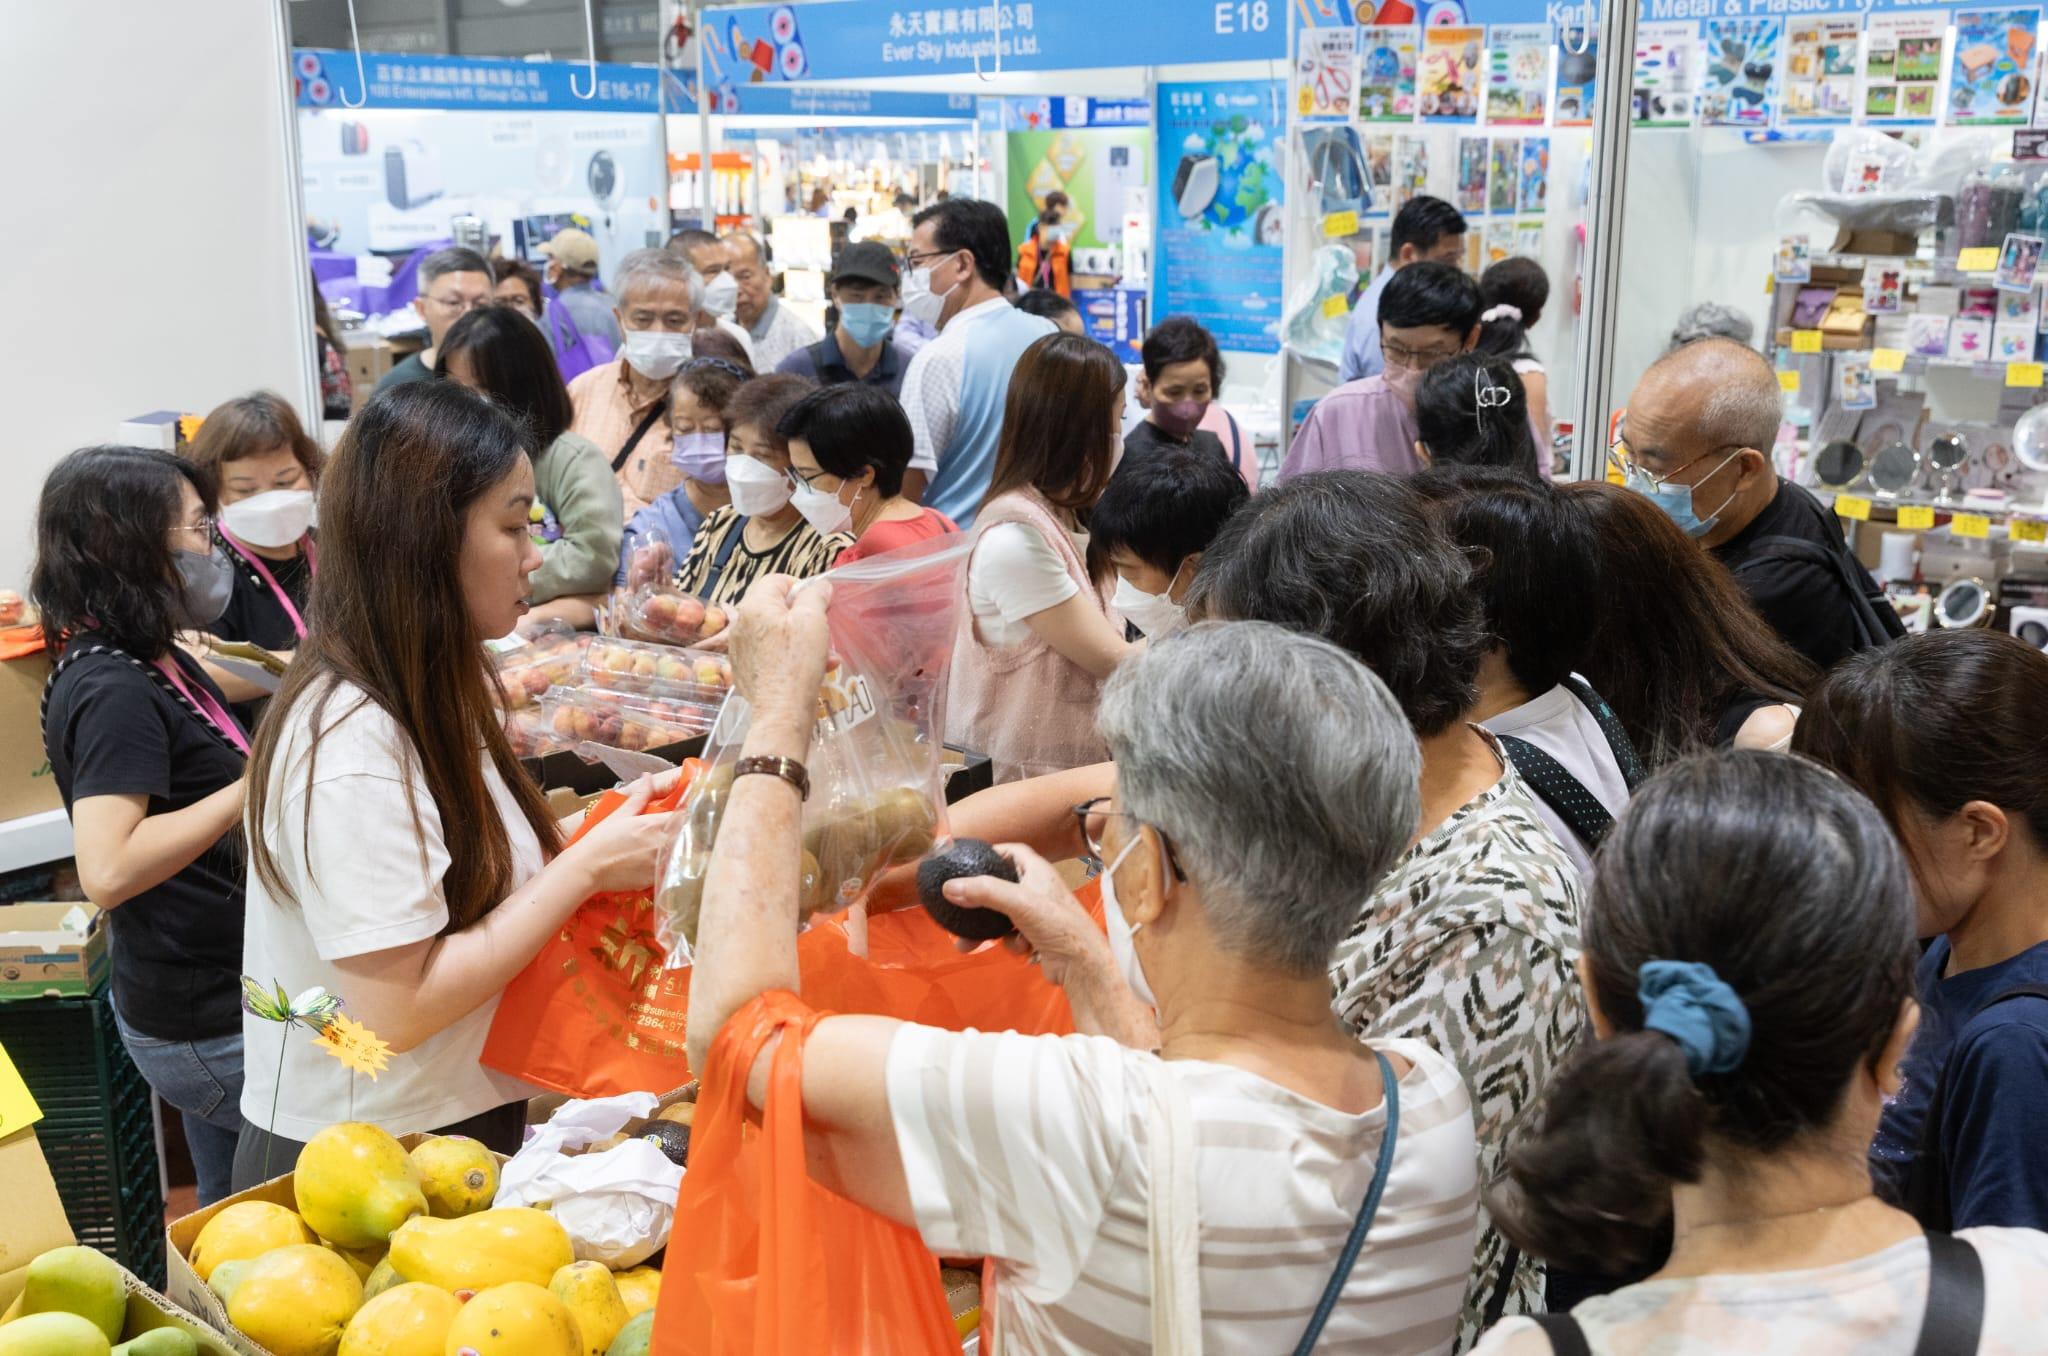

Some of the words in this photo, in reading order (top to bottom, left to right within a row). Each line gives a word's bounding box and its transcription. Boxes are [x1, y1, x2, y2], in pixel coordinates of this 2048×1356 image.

[889, 3, 1034, 38] 永天實業有限公司
[1215, 0, 1269, 34] E18
[1723, 0, 1743, 15] &
[881, 42, 914, 62] Ever
[916, 40, 944, 64] Sky
[1013, 33, 1042, 56] Ltd.
